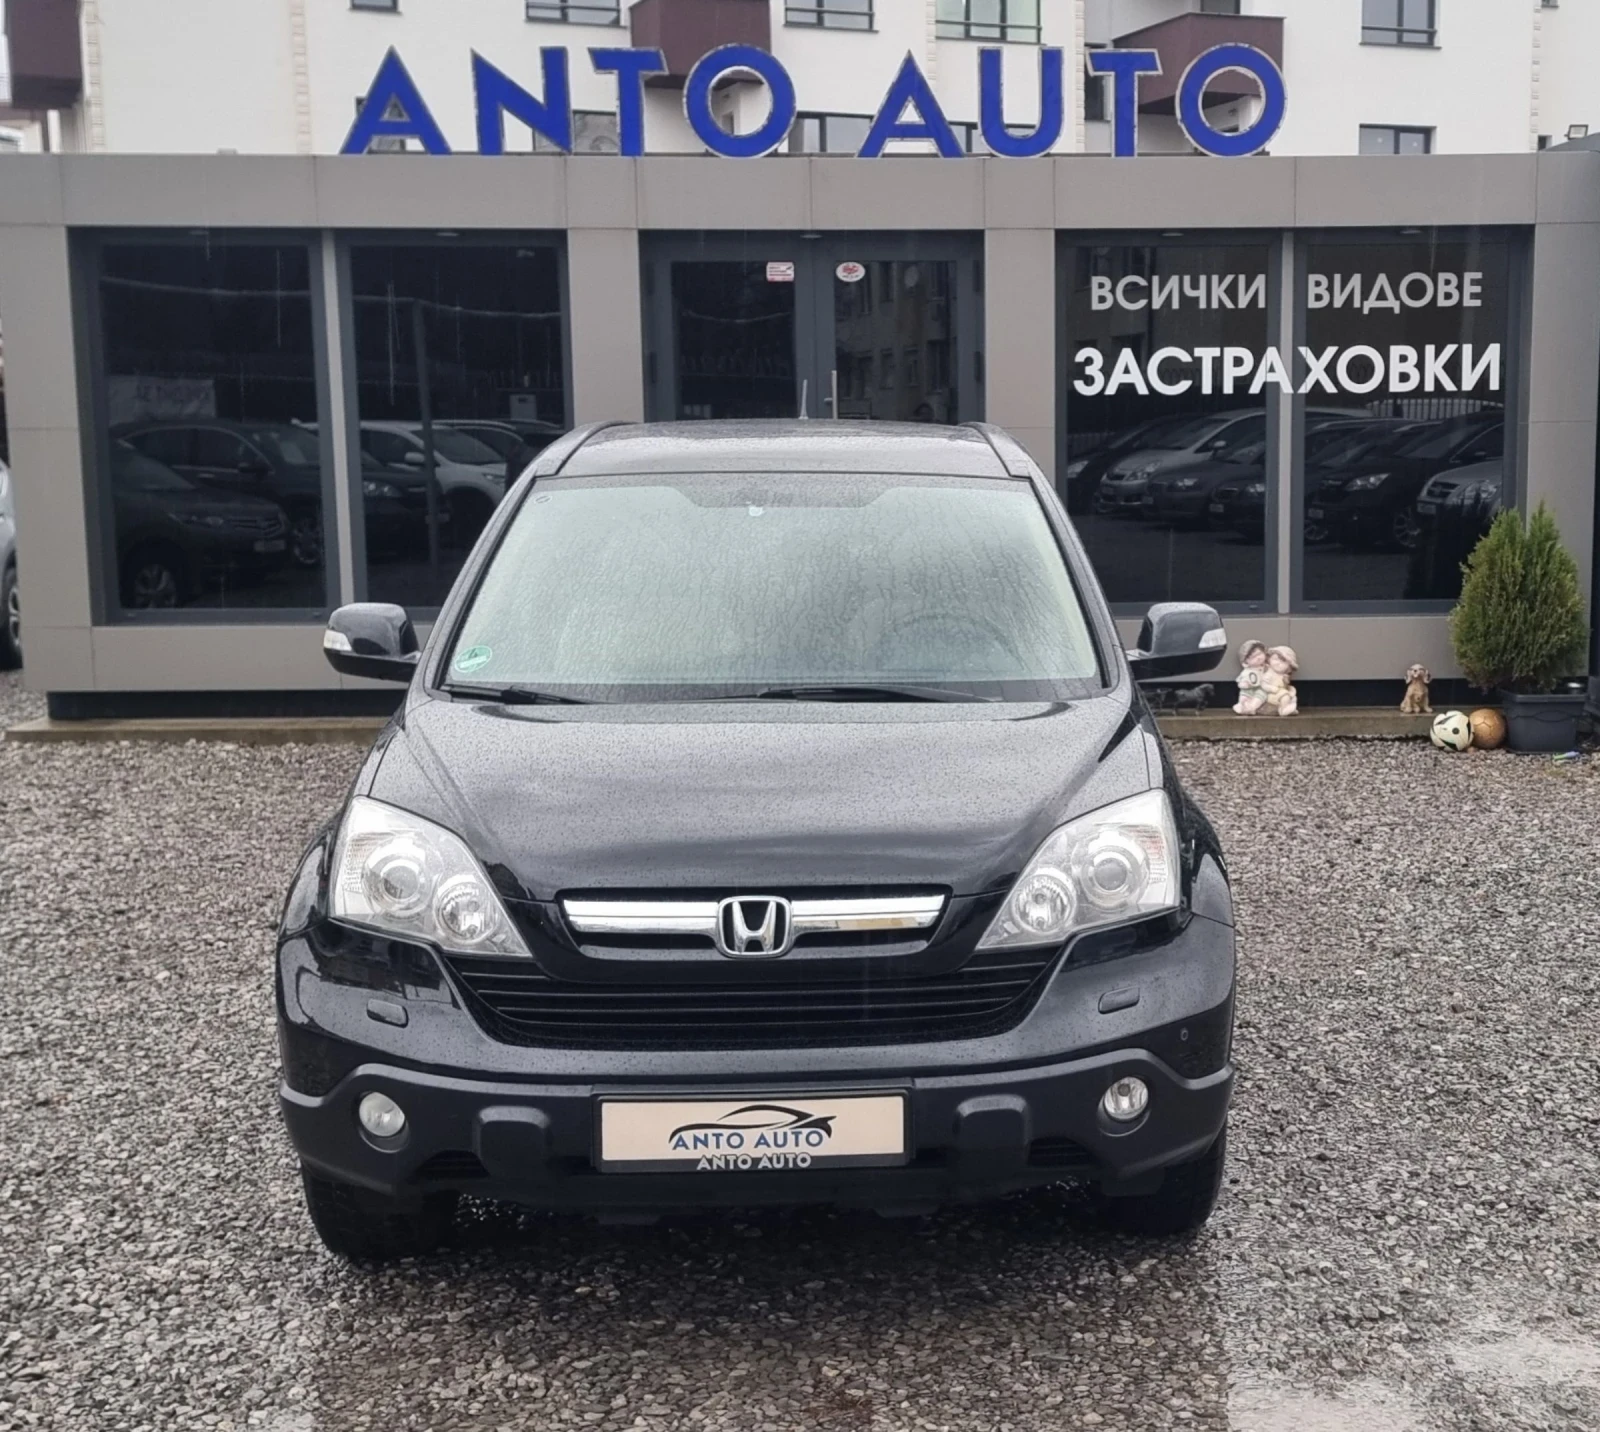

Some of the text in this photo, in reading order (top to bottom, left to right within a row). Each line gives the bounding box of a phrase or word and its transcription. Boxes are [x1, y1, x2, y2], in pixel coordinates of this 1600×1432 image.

[339, 42, 1288, 157] ANTO AUTO
[1091, 271, 1483, 315] ВСИЧКИ ВИДОВЕ
[1073, 343, 1501, 396] ЗАСТРАХОВКИ
[672, 1129, 824, 1150] ANTO AUTO
[696, 1152, 812, 1170] ANTO AUTO
